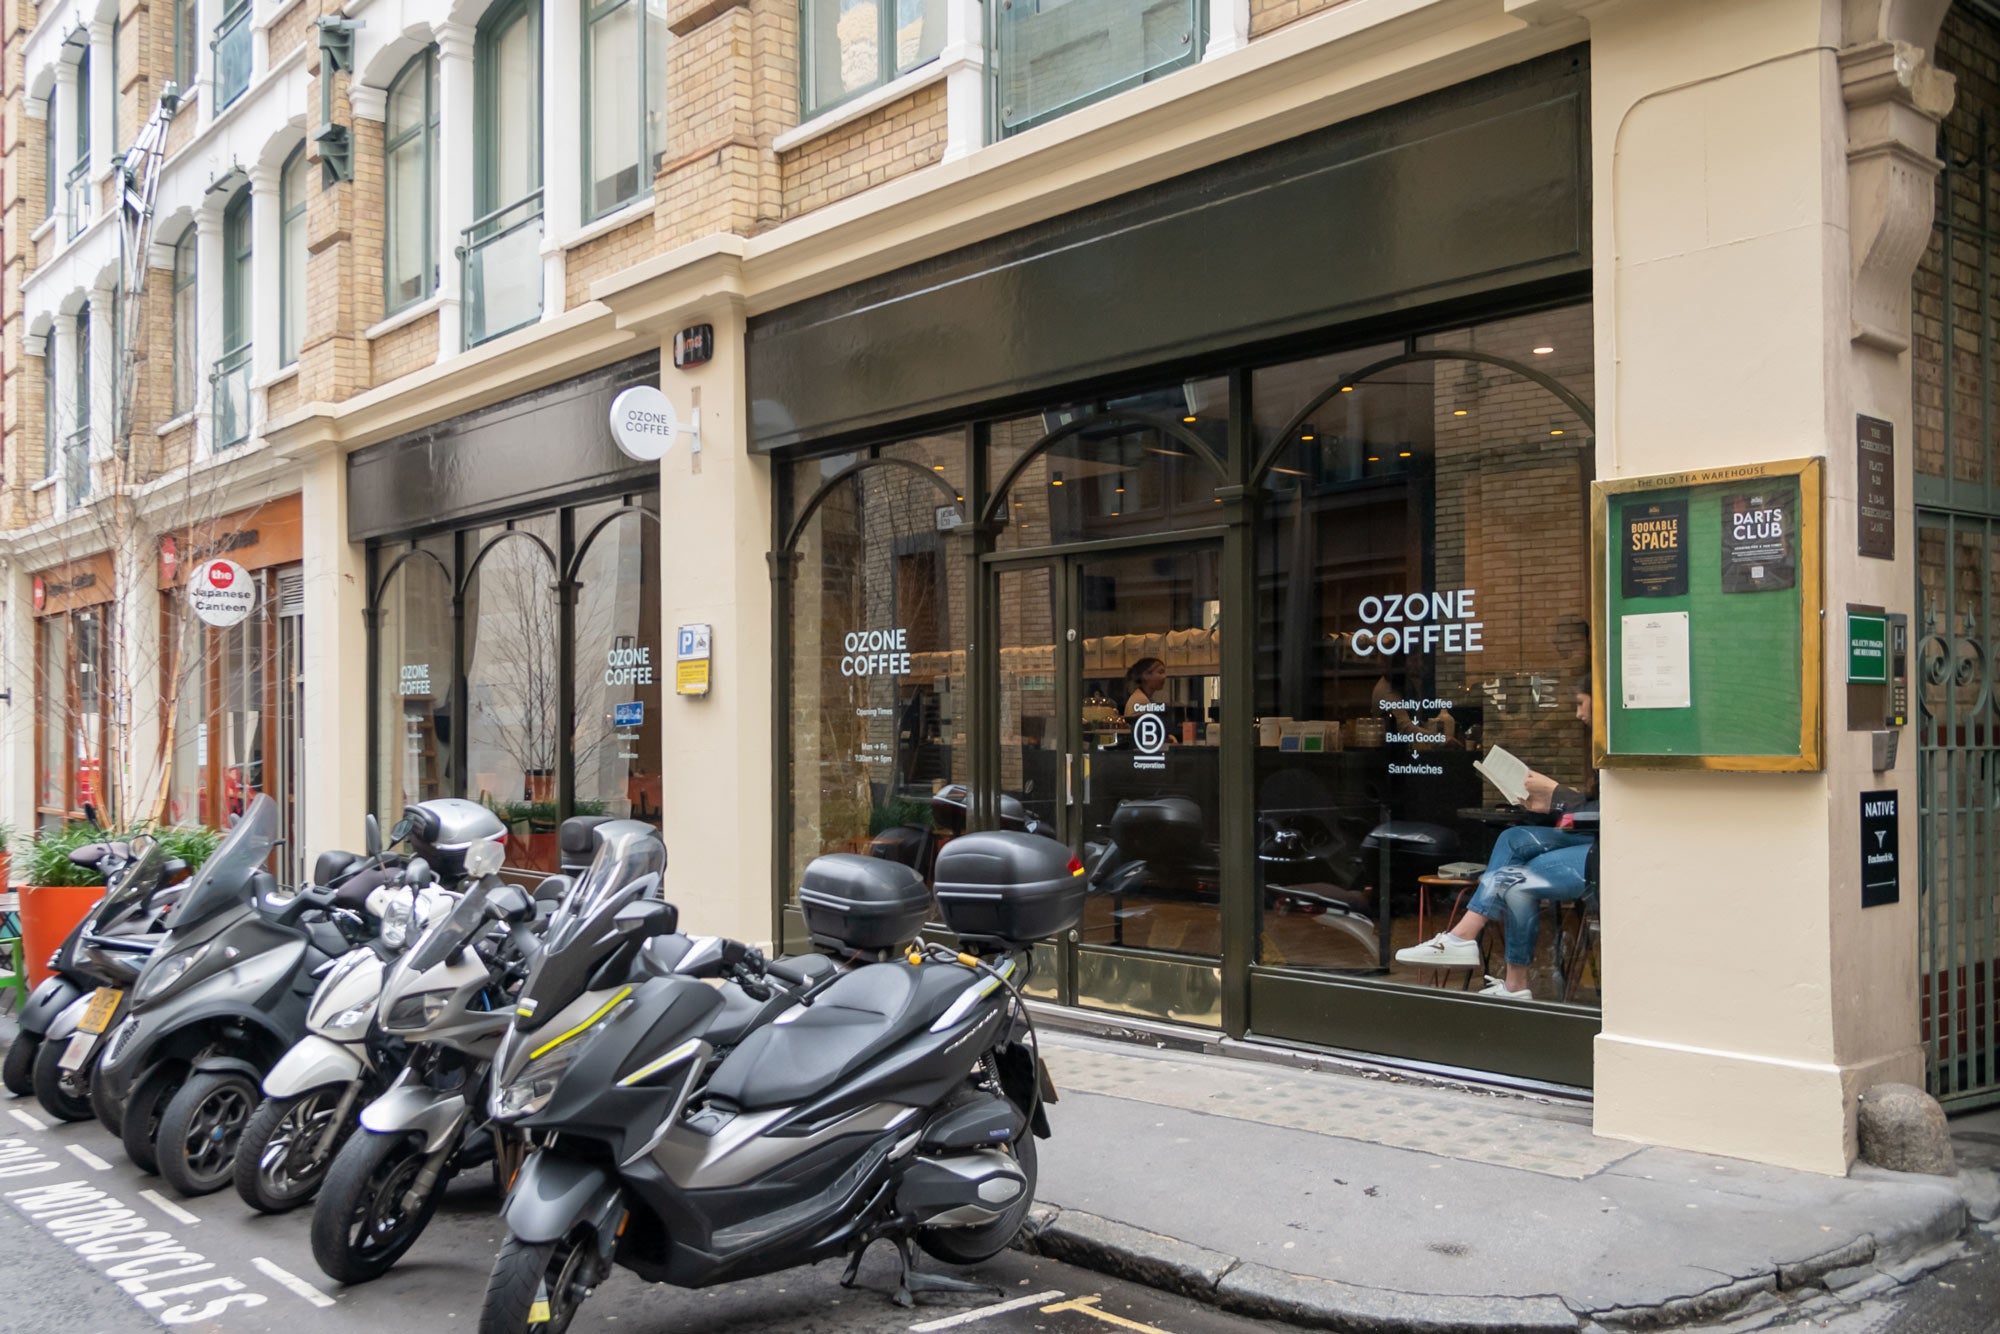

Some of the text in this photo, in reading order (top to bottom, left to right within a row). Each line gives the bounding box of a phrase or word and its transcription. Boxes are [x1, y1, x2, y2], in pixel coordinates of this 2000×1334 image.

[628, 410, 667, 424] OZONE
[625, 421, 670, 436] COFFEE
[1637, 465, 1766, 488] THE OLD TEA WAREHOUSE
[1733, 508, 1782, 526] DARTS
[1631, 519, 1678, 534] BOOKABLE
[1733, 522, 1782, 540] CLUB
[1632, 529, 1678, 551] SPACE
[211, 569, 232, 580] the
[192, 588, 251, 599] Japanese
[195, 601, 247, 612] Canteen
[1358, 589, 1476, 624] OZONE
[844, 628, 907, 653] OZONE
[1351, 622, 1484, 656] COFFEE
[607, 647, 650, 666] OZONE
[841, 653, 911, 676] COFFEE
[401, 664, 429, 680] OZONE
[605, 667, 653, 686] COFFEE
[399, 680, 431, 695] COFFEE
[1133, 702, 1165, 712] Certified
[1379, 698, 1453, 711] Specialty Coffee
[1142, 721, 1157, 746] B
[1385, 732, 1446, 743] Baked Goods
[1133, 762, 1165, 770] Corporation
[1388, 763, 1443, 774] Sandwiches
[1865, 800, 1894, 817] NATIVE
[3, 1180, 268, 1325] MOTORCYCLES
